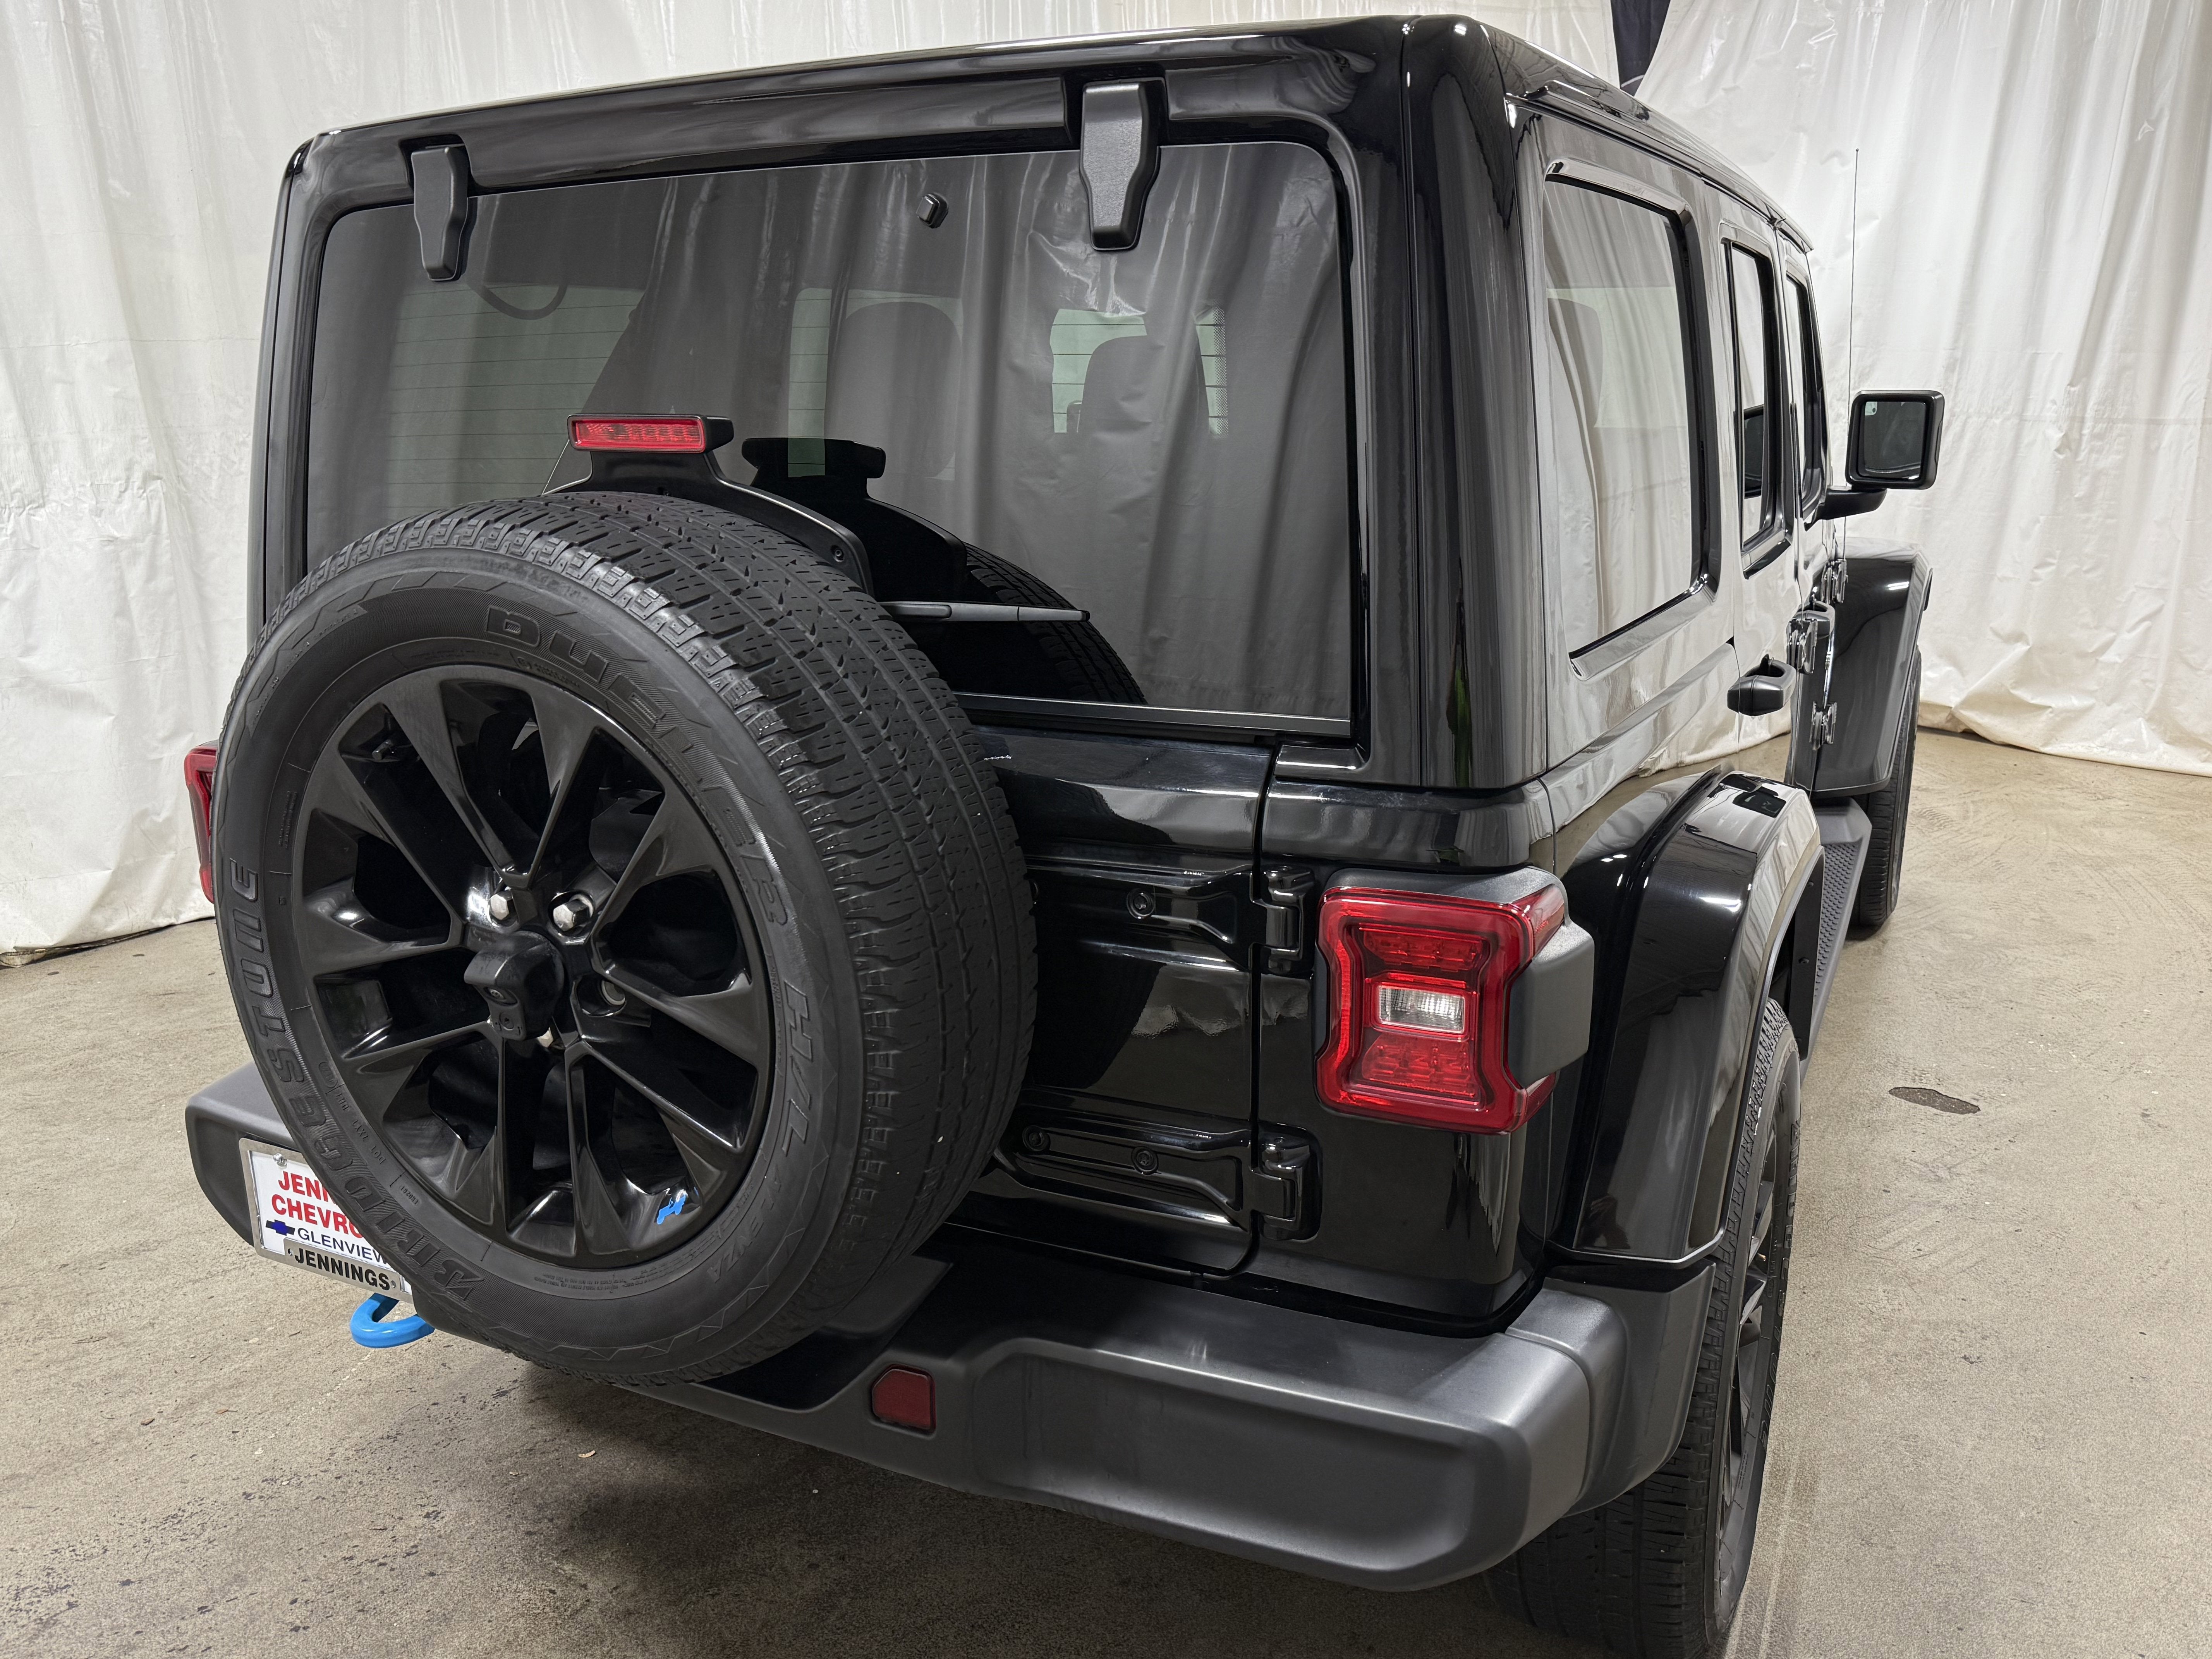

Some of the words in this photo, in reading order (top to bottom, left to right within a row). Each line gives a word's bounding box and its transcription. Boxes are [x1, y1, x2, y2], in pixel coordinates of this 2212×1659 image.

[486, 605, 788, 926] DUELER
[782, 981, 813, 1157] H/L
[229, 857, 485, 1301] BRIDGESTONE
[295, 1248, 390, 1290] JENNINGS
[298, 1228, 387, 1264] GLENVIEW
[707, 1164, 781, 1283] ALENZA
